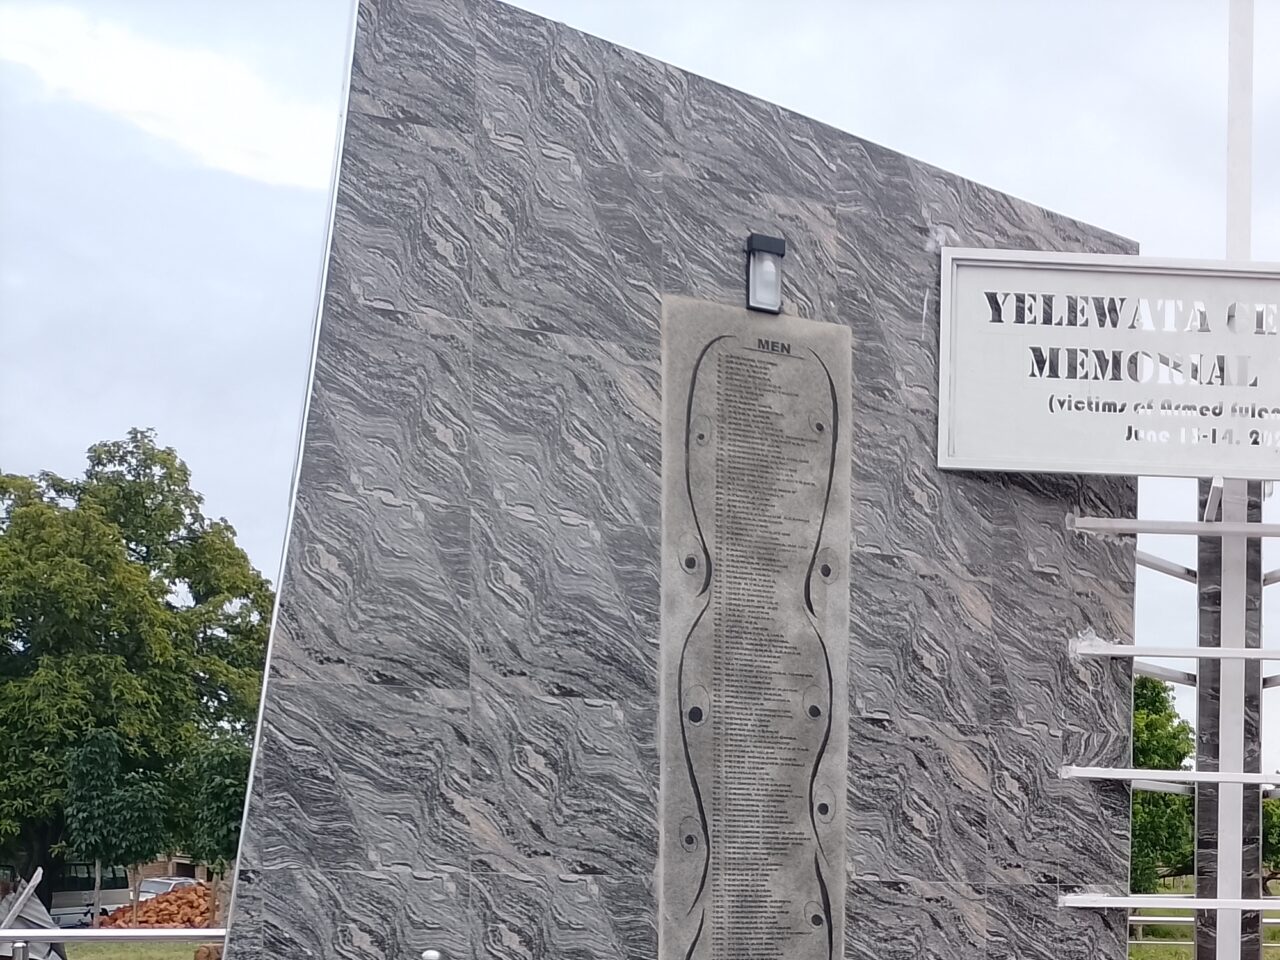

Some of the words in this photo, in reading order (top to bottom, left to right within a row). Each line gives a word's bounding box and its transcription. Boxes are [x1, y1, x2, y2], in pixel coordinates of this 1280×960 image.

[984, 291, 1211, 333] YELEWATA
[757, 338, 791, 354] MEN
[1029, 346, 1258, 388] MEMORIAL
[1049, 394, 1127, 413] (victims
[1125, 425, 1171, 442] June
